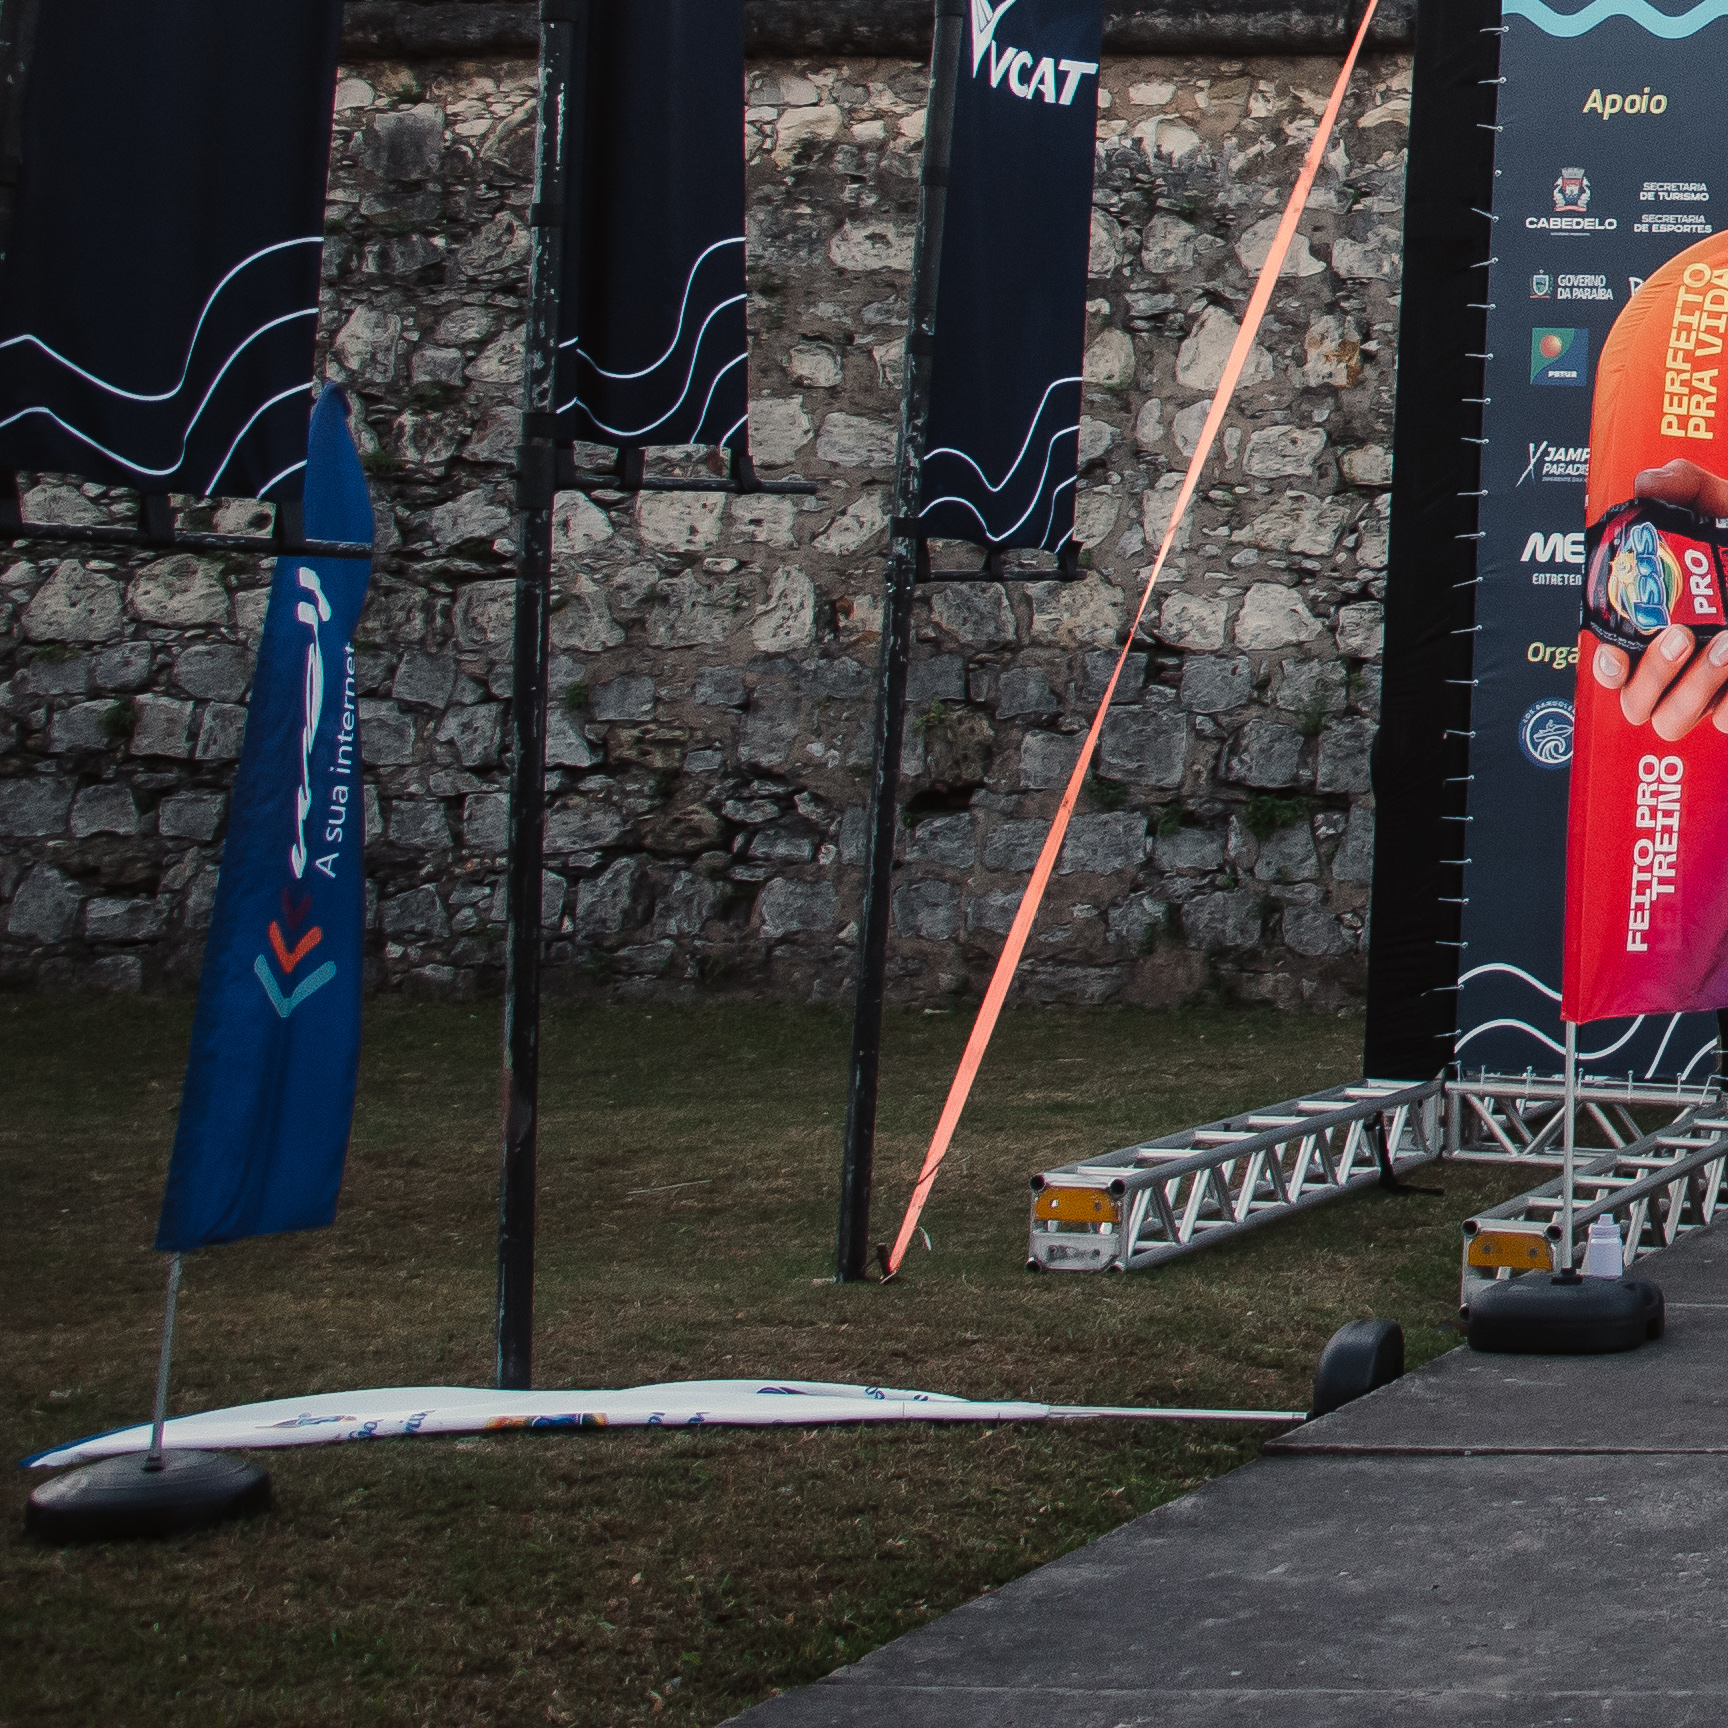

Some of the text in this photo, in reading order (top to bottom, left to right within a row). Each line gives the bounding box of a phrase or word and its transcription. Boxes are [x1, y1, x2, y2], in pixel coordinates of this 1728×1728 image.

[991, 39, 1099, 105] VCAT
[1582, 87, 1668, 120] Apoio
[1640, 192, 1709, 202] DE TURISMO
[1643, 182, 1707, 191] SECRETARIA
[1525, 217, 1618, 230] CABEDELO
[1634, 224, 1712, 234] DE ESPORTES
[1642, 214, 1706, 223] SECRETARIA
[1557, 275, 1607, 286] GOVERNO
[1557, 288, 1571, 299] DA
[1660, 262, 1711, 438] PERFEITO
[1687, 368, 1719, 440] PRA
[1684, 549, 1717, 614] PRO
[315, 642, 356, 878] A sua internet
[1651, 755, 1683, 901] TREINO
[1626, 754, 1660, 952] FEITO PRO
